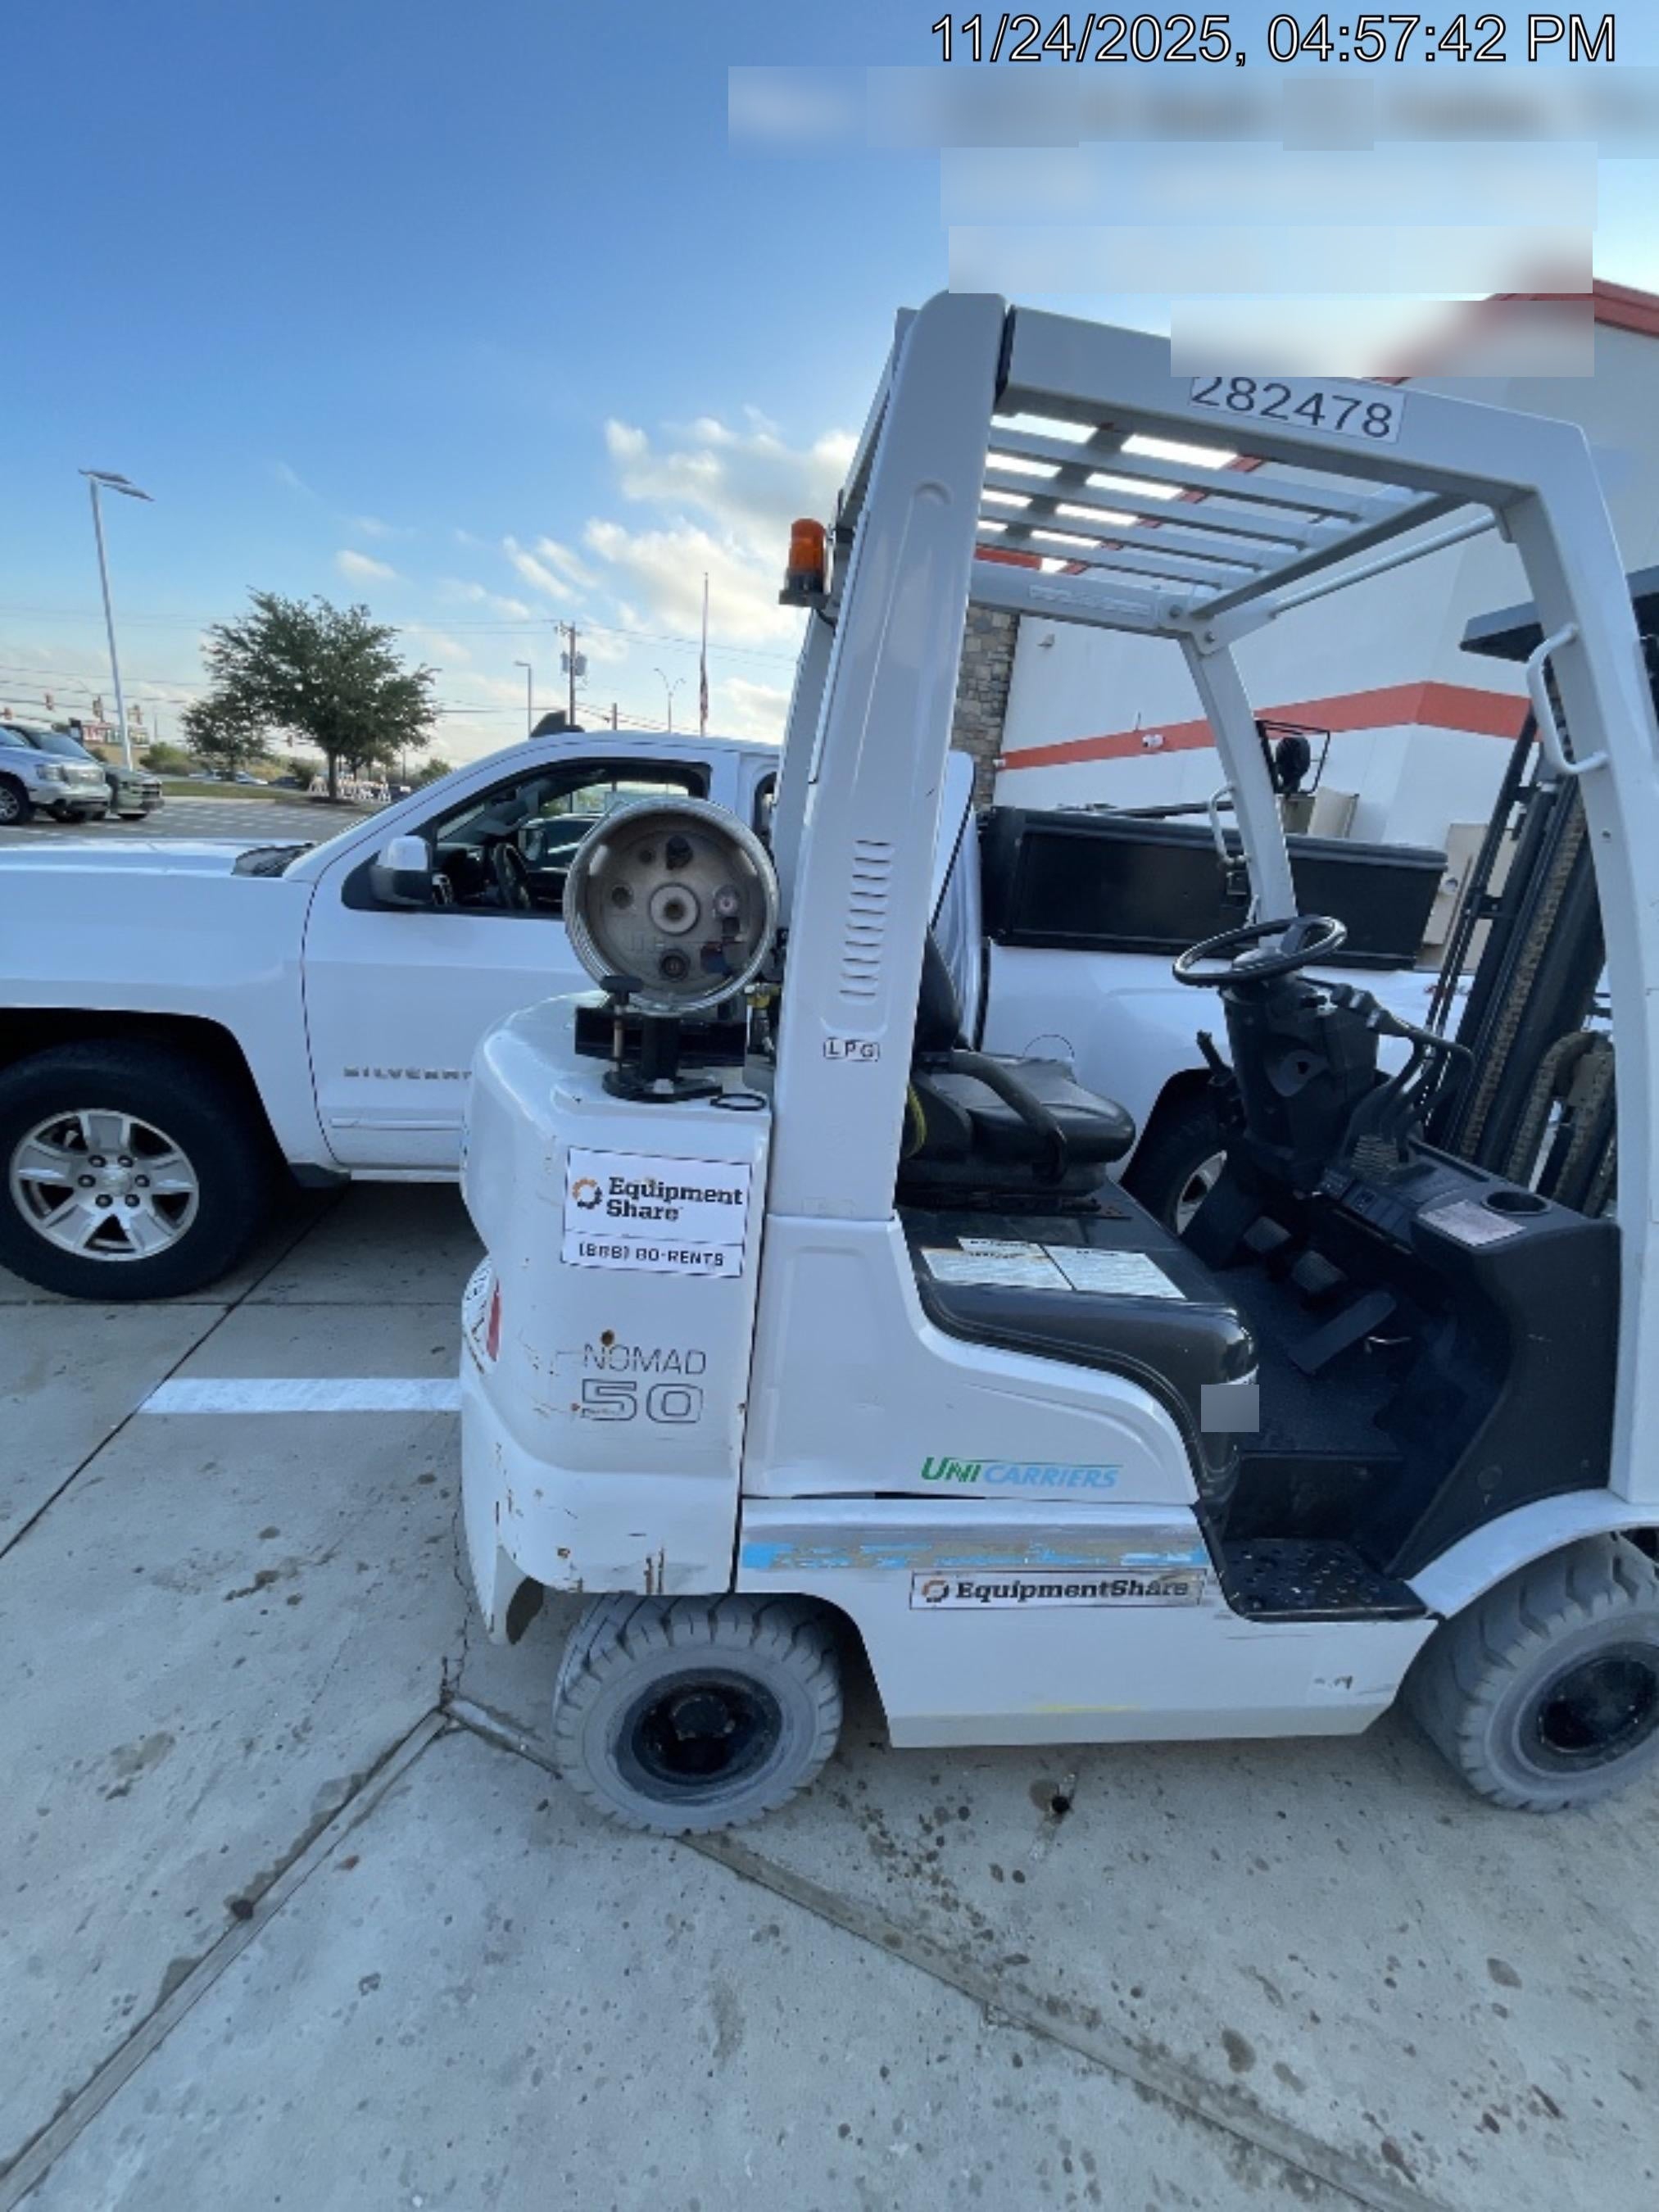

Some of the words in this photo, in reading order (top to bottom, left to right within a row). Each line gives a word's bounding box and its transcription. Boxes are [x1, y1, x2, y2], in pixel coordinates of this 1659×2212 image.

[1190, 377, 1393, 438] 282478
[828, 1040, 874, 1058] LPG
[609, 1176, 743, 1204] Equipment
[606, 1199, 679, 1222] Share
[583, 1344, 706, 1376] NOMAD
[581, 1378, 704, 1424] 50
[955, 1578, 1189, 1603] EquipmentShare
